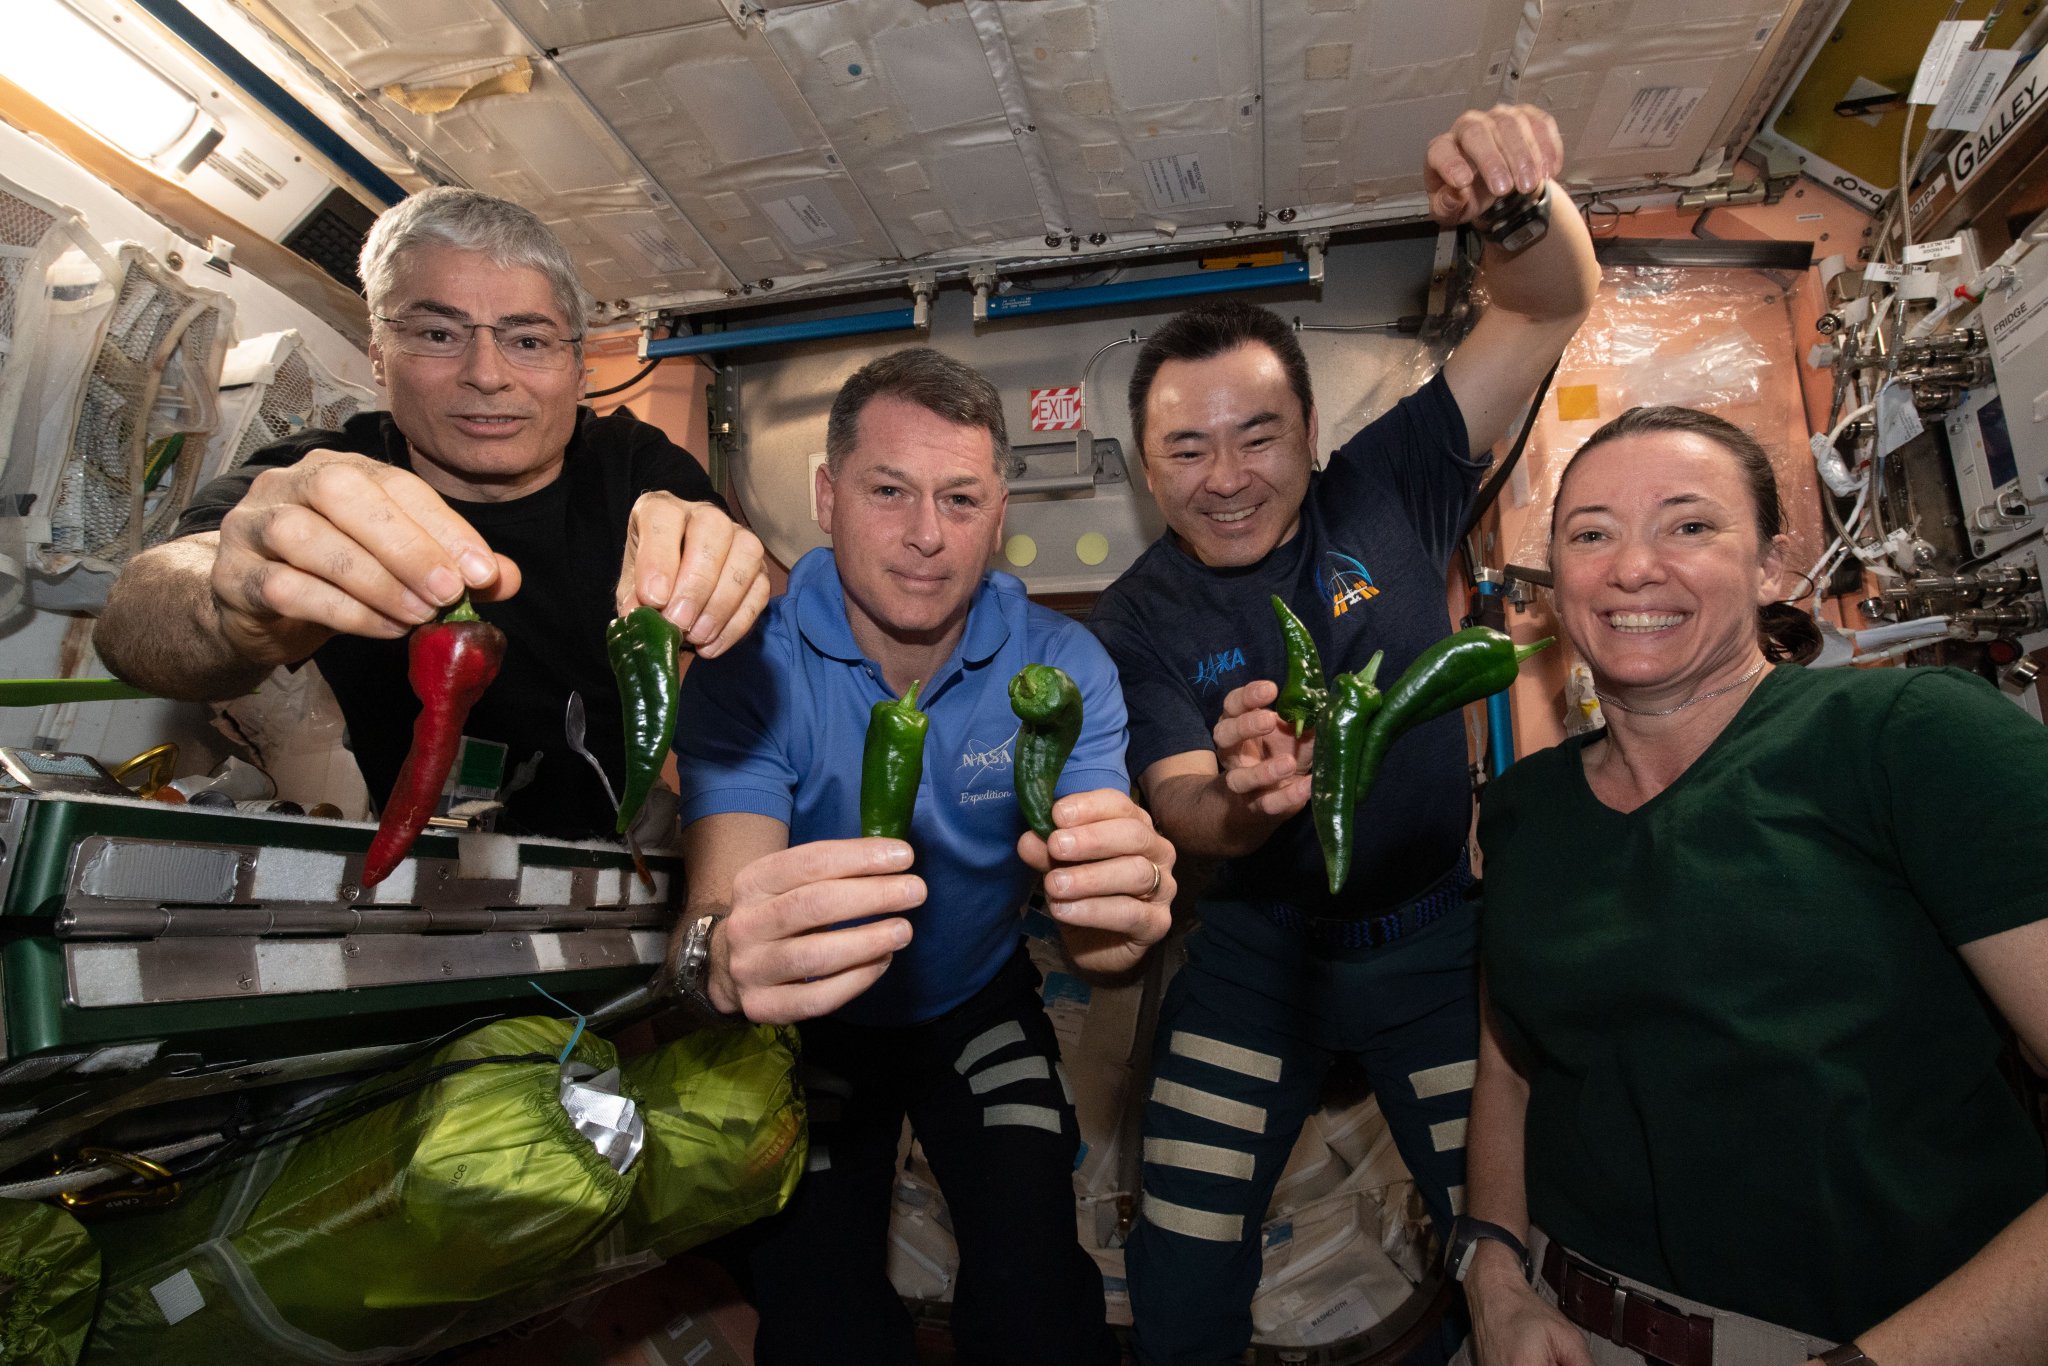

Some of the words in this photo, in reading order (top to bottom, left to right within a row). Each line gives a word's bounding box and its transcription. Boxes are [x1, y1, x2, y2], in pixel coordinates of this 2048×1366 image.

[1954, 77, 2038, 180] GALLEY
[1993, 301, 2028, 335] FRIDGE
[1039, 398, 1072, 420] EXIT
[1192, 647, 1246, 686] JAXA
[962, 749, 1012, 767] NASA
[959, 790, 1012, 805] Expedition
[105, 1198, 140, 1208] CAMP
[1311, 1300, 1348, 1328] WASHCLOTH
